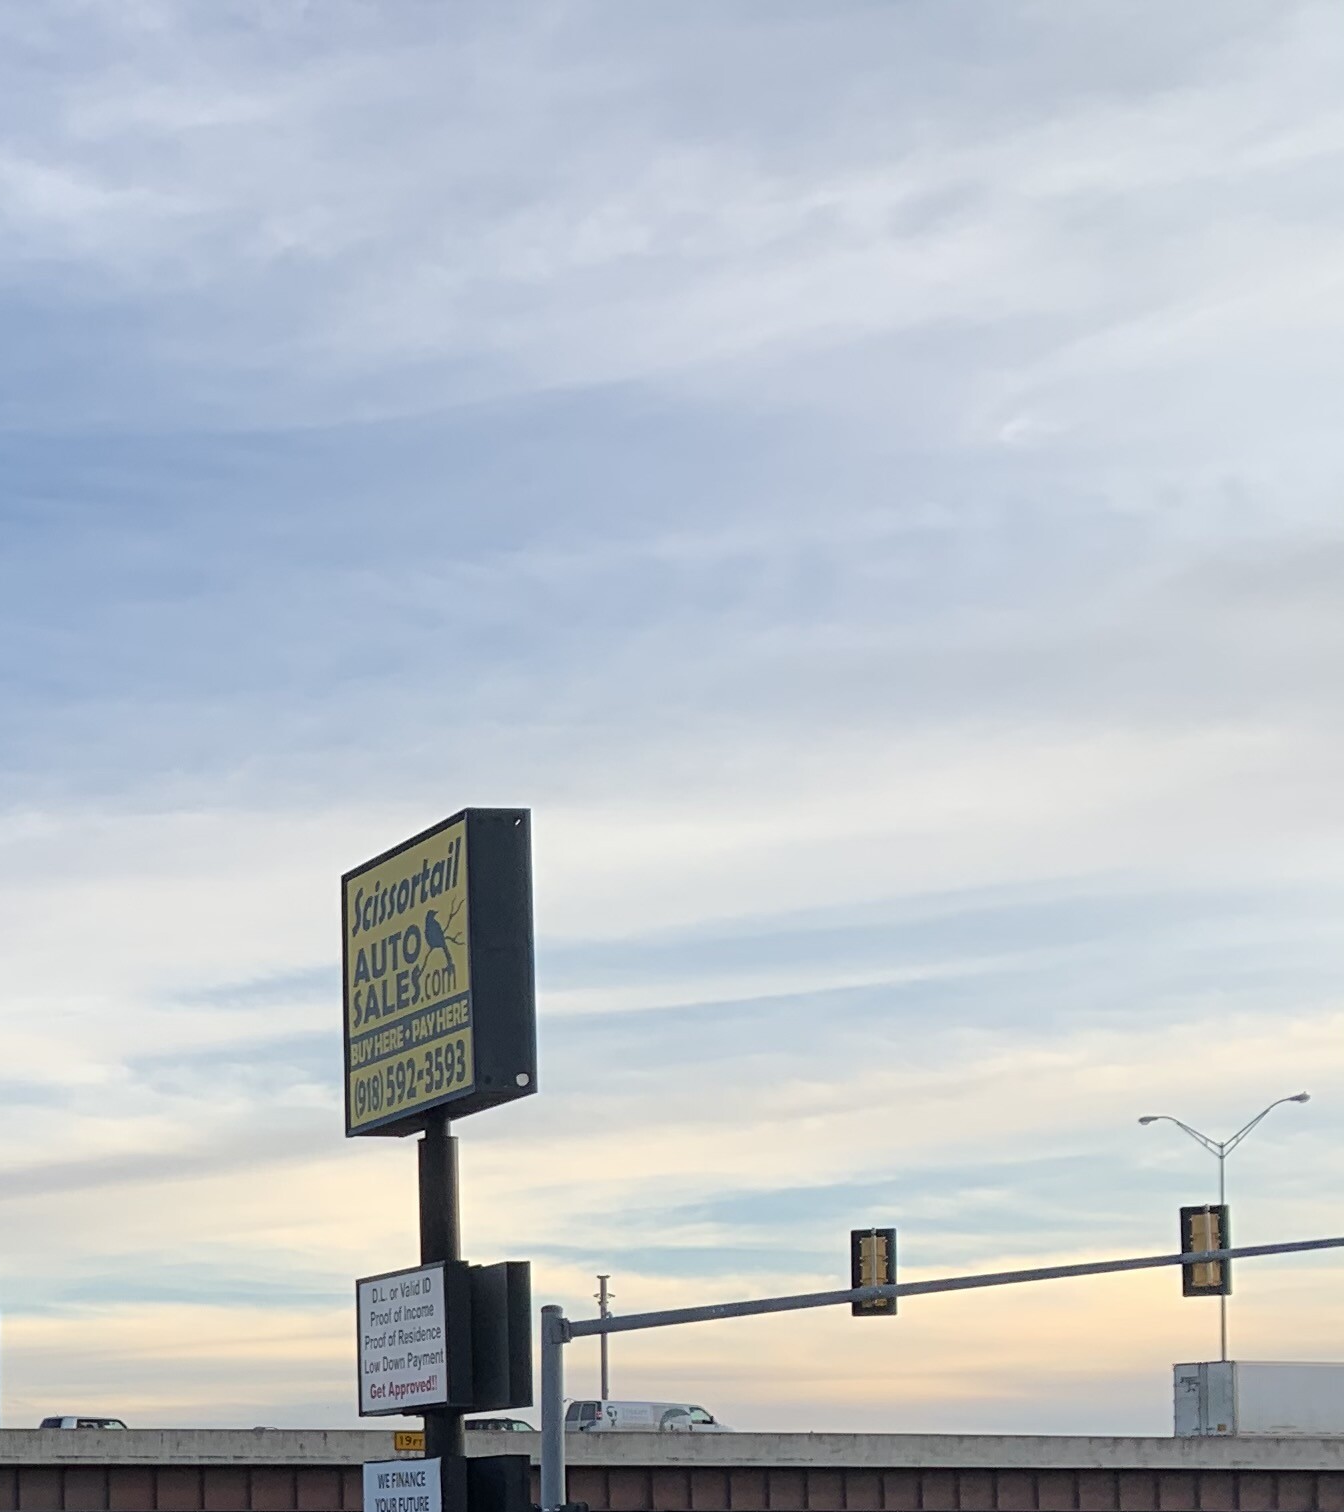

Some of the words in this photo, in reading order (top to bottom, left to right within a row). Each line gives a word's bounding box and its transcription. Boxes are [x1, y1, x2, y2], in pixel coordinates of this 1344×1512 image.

[352, 836, 462, 938] Scissortail
[353, 923, 422, 988] AUTO
[351, 1037, 373, 1067] BUY
[374, 1025, 404, 1057] HERE
[412, 1012, 436, 1042] PAY
[436, 999, 469, 1033] HERE
[355, 1069, 383, 1119] (918)
[386, 1039, 466, 1107] 592-3593
[390, 1288, 399, 1301] or
[399, 1280, 420, 1298] Valid
[422, 1277, 432, 1294] ID
[370, 1308, 392, 1327] Proof
[393, 1306, 402, 1322] of
[404, 1304, 434, 1321] Income
[364, 1332, 387, 1350] Proof
[388, 1330, 397, 1347] of
[398, 1326, 442, 1346] Residence
[364, 1359, 380, 1374] Low
[382, 1356, 405, 1371] Down
[407, 1348, 444, 1371] Payment
[370, 1383, 386, 1399] Get
[377, 1473, 390, 1489] WE
[391, 1471, 426, 1488] FINANCE
[398, 1496, 430, 1512] FUTURE
